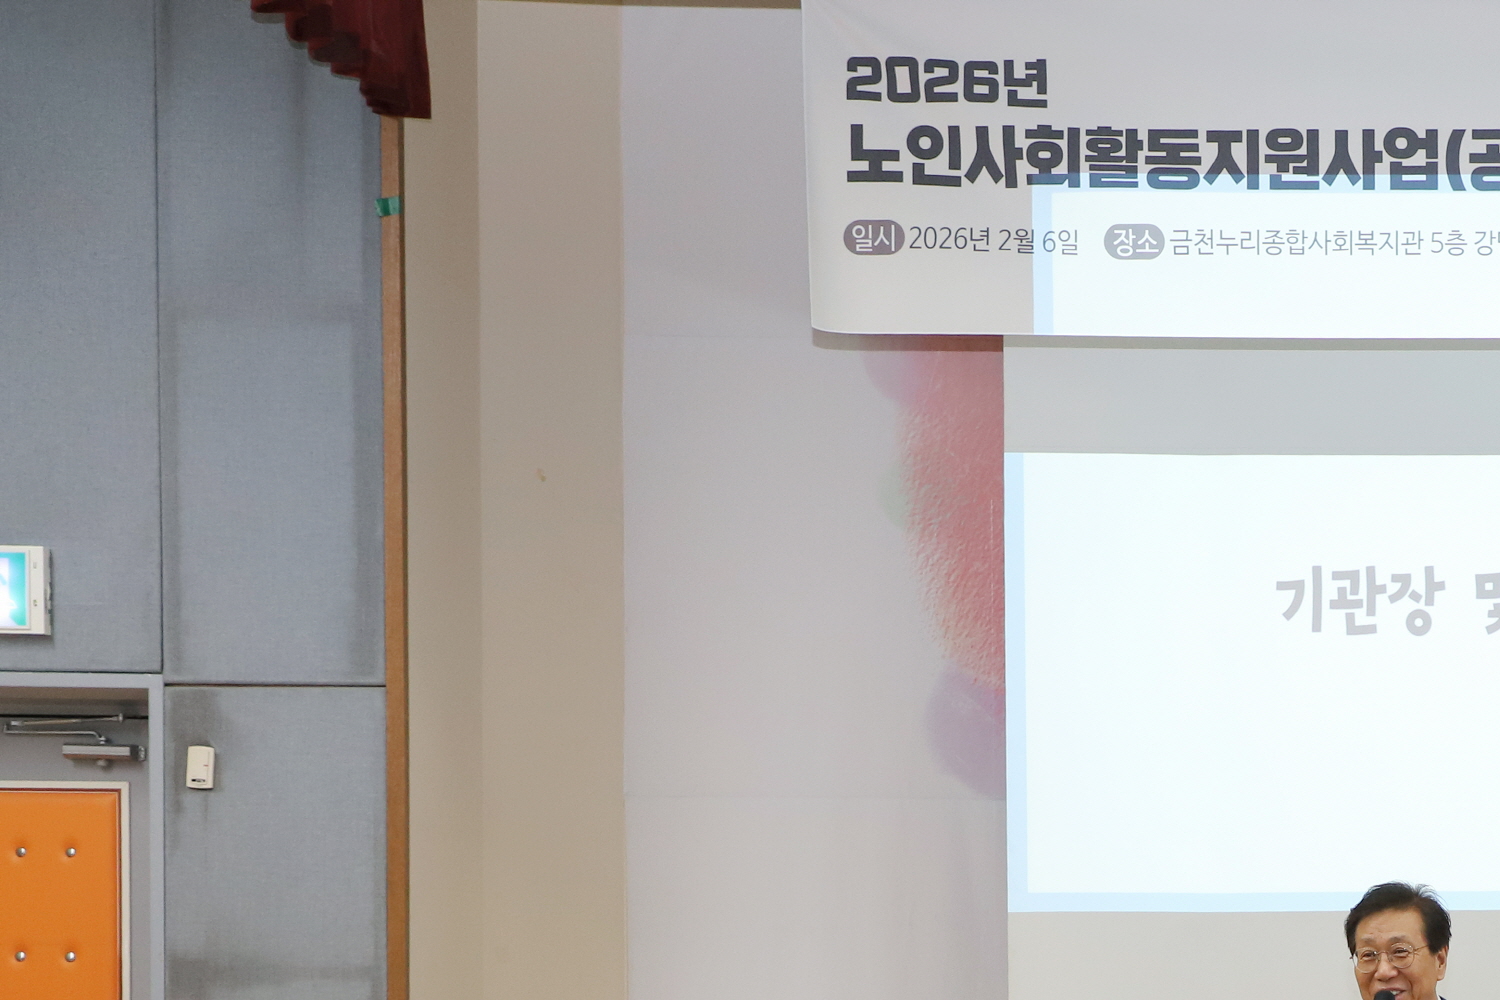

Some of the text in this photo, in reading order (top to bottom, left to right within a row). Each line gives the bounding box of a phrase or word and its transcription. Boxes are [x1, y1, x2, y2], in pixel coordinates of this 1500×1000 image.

[846, 55, 1049, 109] 2026년
[851, 224, 1079, 255] 일시 2026년 2월 6일
[1112, 229, 1160, 257] 장소
[1169, 229, 1424, 256] 금천누리종합사회복지관
[1430, 230, 1468, 256] 5층
[1276, 565, 1446, 637] 기관장
